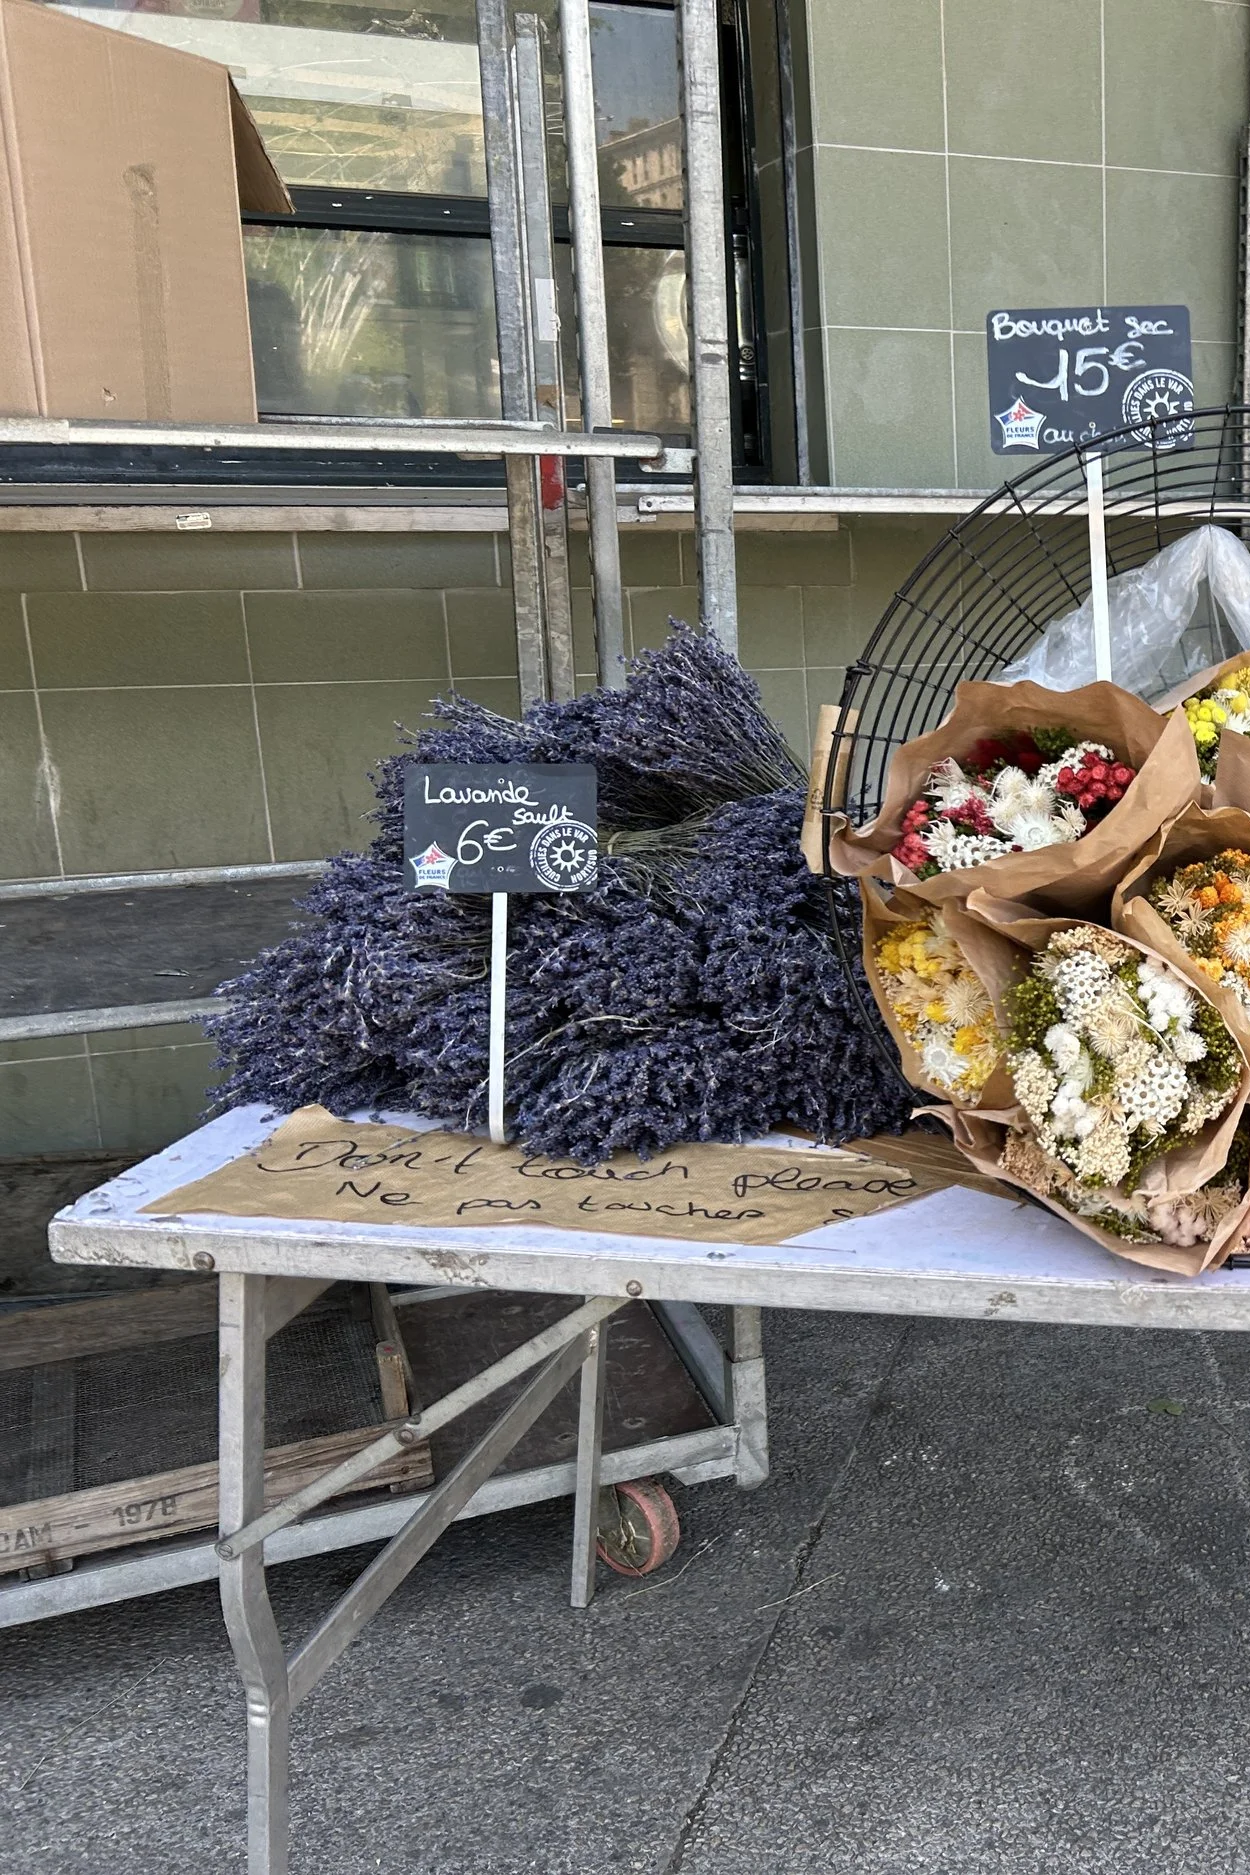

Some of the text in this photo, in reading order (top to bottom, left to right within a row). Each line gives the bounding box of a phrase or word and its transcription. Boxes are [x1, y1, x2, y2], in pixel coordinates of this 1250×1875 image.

[992, 309, 1109, 341] Bouquet
[1134, 380, 1154, 400] DANS
[1156, 378, 1165, 388] LE
[1168, 379, 1184, 395] VAR
[425, 776, 539, 806] Lavande
[457, 820, 517, 864] 6€
[541, 829, 562, 847] DANS
[562, 828, 572, 837] LE
[574, 829, 589, 843] VAR
[571, 849, 598, 883] HORTISUD
[512, 1154, 689, 1180] touch
[732, 1167, 917, 1197] please
[336, 1181, 424, 1206] Ne
[457, 1197, 542, 1215] pas
[578, 1196, 765, 1220] toucher
